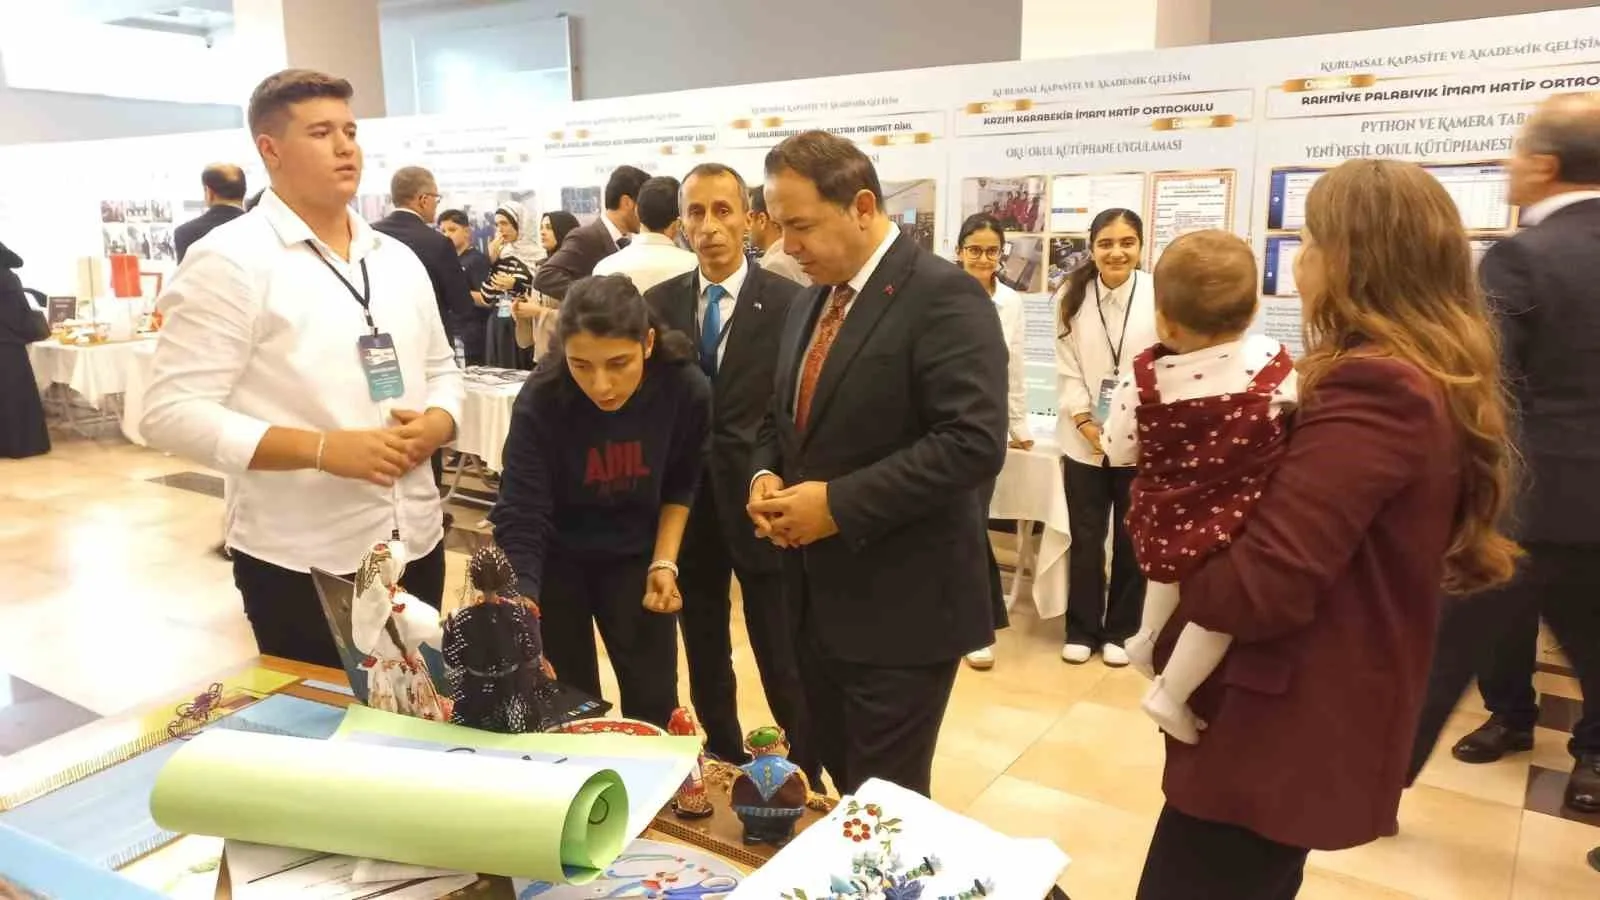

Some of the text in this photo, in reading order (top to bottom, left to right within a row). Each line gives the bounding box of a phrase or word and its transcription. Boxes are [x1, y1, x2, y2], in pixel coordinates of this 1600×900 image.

[1320, 56, 1384, 72] KURUMSAL
[1387, 50, 1447, 67] KAPASİTE
[1450, 50, 1465, 60] VE
[1468, 42, 1541, 61] AKADEMİK
[1301, 91, 1361, 105] RAHMİYE
[1364, 87, 1438, 102] PALABIYIK
[1441, 84, 1486, 97] İMAM
[1489, 78, 1535, 94] HATİP
[983, 102, 1214, 126] KAZIM KARABEKİR İMAM HATİP ORTAOKULU
[1360, 111, 1531, 133] PYTHON VE KAMERA TAB
[1305, 135, 1512, 159] YENİ NESİL OKUL KÜTÜPHANESİ
